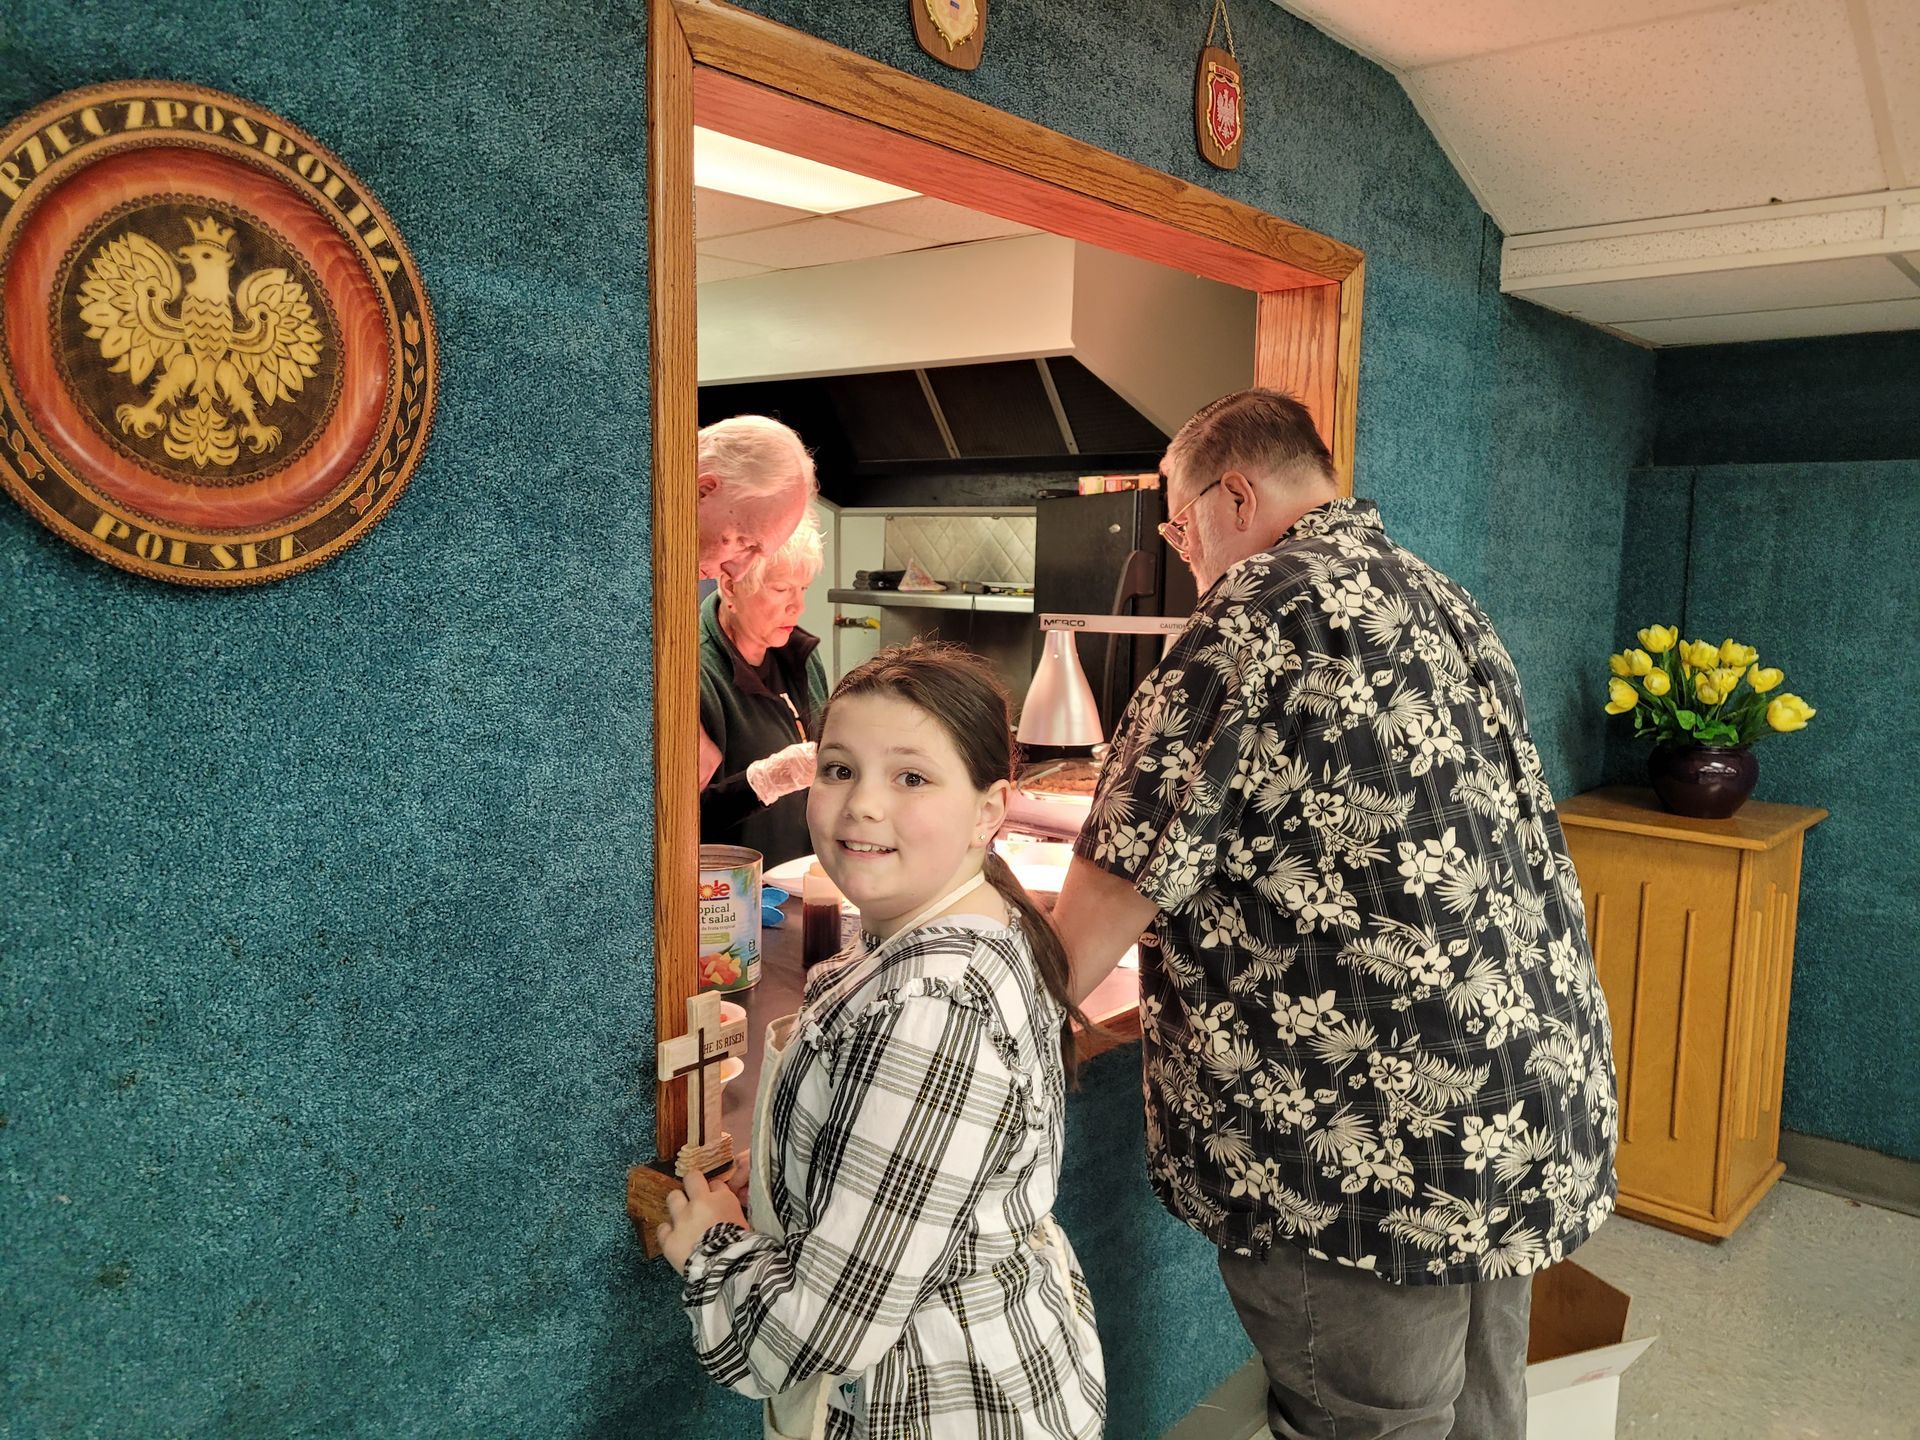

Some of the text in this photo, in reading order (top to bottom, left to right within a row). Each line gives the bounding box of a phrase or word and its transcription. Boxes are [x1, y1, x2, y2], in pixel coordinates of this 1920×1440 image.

[0, 99, 401, 281] RZECZPOSPOLITA
[91, 512, 309, 570] POLSKA
[1043, 618, 1086, 627] MERCO
[699, 880, 730, 897] ole
[699, 903, 730, 916] opical
[708, 912, 736, 924] salad
[716, 1038, 723, 1051] IS
[724, 1031, 745, 1047] RISEN
